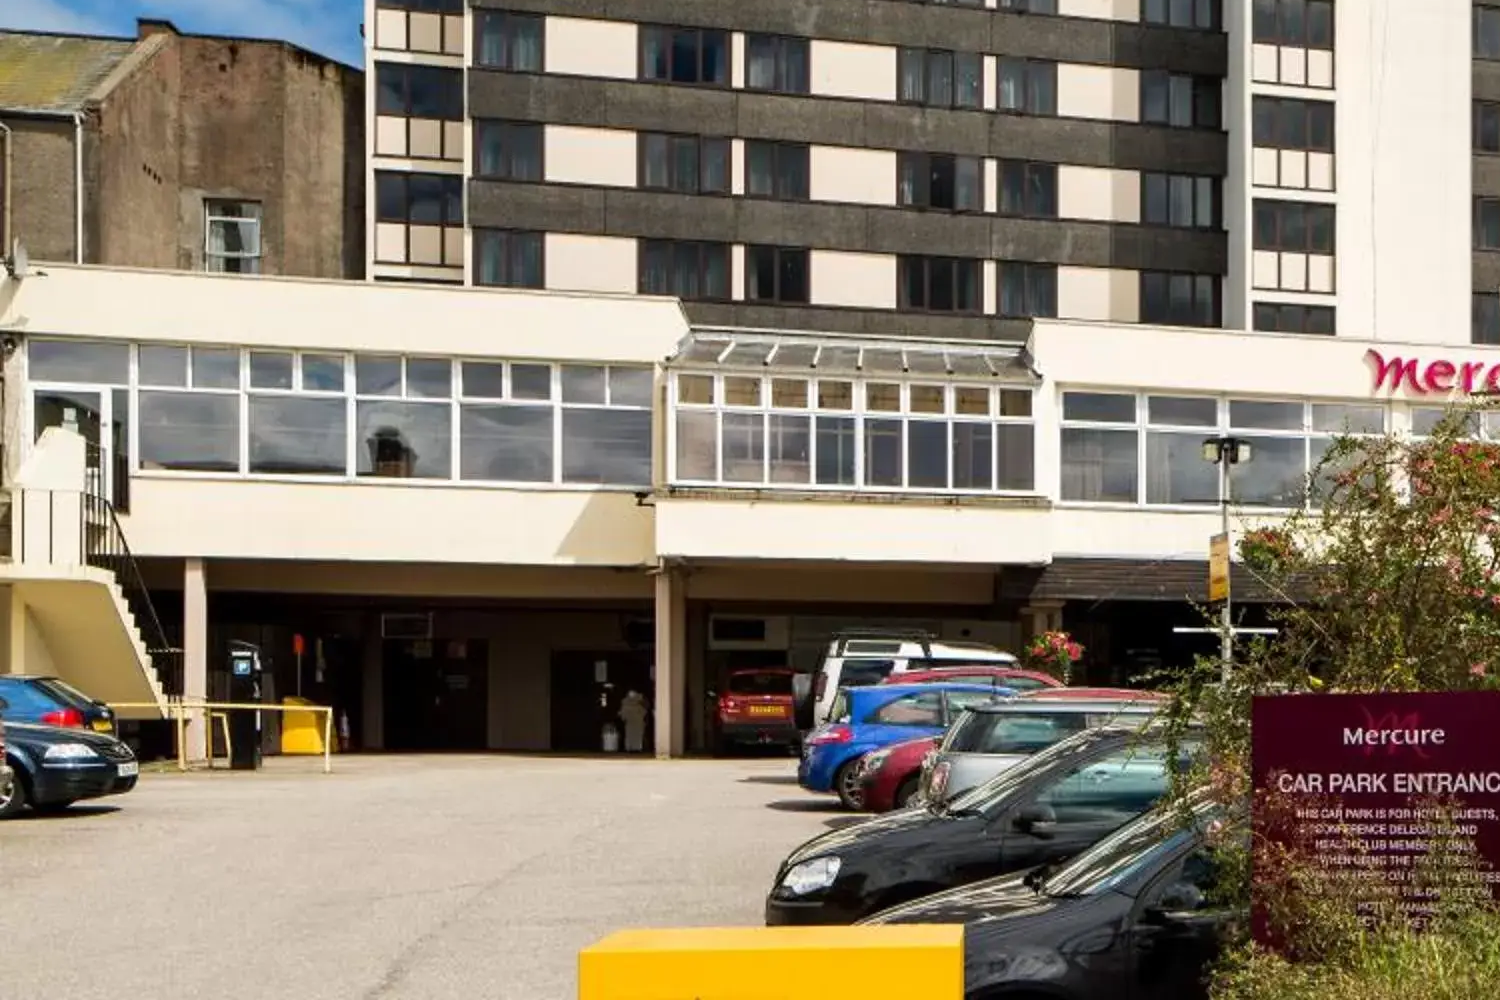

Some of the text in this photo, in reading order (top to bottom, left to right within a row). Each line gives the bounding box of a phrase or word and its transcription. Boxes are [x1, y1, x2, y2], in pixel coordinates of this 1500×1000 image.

[1343, 727, 1446, 745] Mercure
[1278, 773, 1322, 793] CAR
[1329, 773, 1388, 793] PARK
[1345, 808, 1374, 818] PARK
[1376, 808, 1386, 818] IS
[1388, 808, 1411, 818] FOR
[1390, 856, 1411, 866] THE
